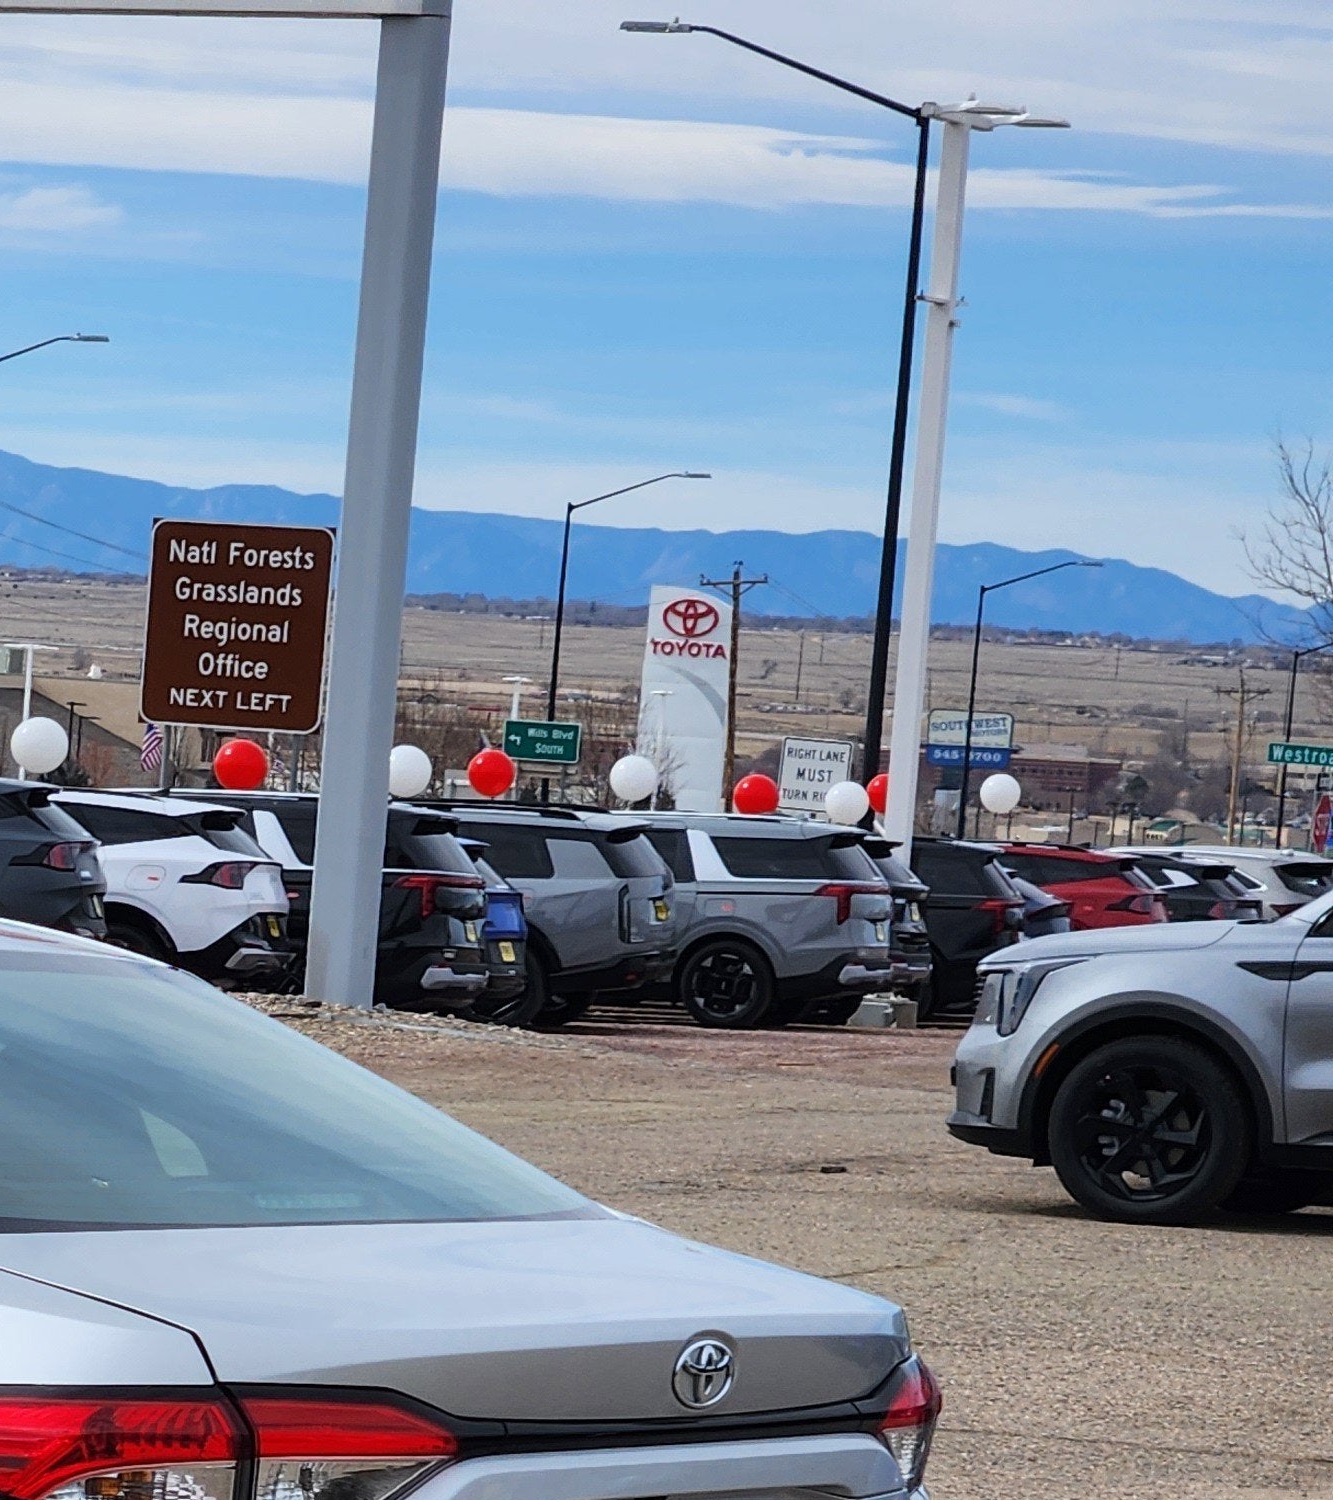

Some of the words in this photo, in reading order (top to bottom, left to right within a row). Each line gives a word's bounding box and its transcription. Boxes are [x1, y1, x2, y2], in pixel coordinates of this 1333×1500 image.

[169, 539, 217, 565] Natl
[228, 542, 315, 570] Forests
[175, 576, 303, 607] Grasslands
[183, 613, 290, 647] Regional
[650, 638, 727, 659] TOYOTA
[198, 652, 269, 680] Office
[169, 688, 228, 708] NEXT
[236, 692, 292, 713] LEFT
[931, 717, 1008, 731] SOUTWEST
[787, 748, 817, 760] RIGHT
[819, 751, 846, 762] LANE
[796, 767, 834, 783] MUST
[782, 788, 808, 800] TURN
